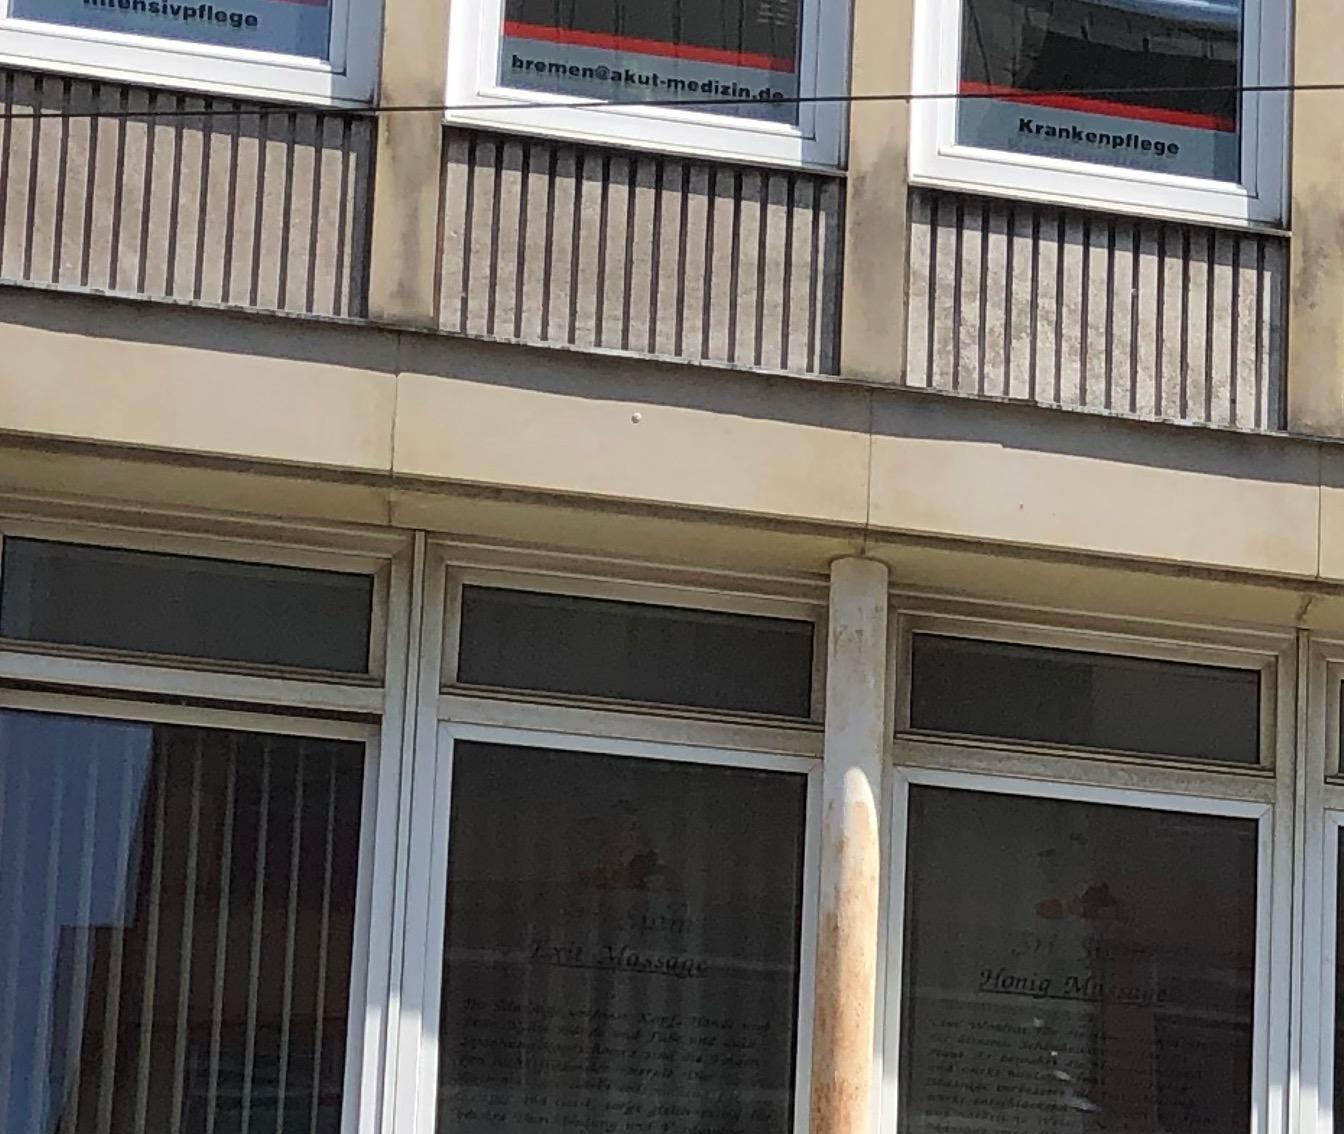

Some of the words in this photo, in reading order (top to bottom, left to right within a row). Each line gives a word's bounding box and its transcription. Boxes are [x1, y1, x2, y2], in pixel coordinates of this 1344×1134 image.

[511, 54, 784, 101] bremen@akut-medizin.de
[1018, 118, 1180, 156] Krankenpflege
[979, 968, 1051, 998] Honig
